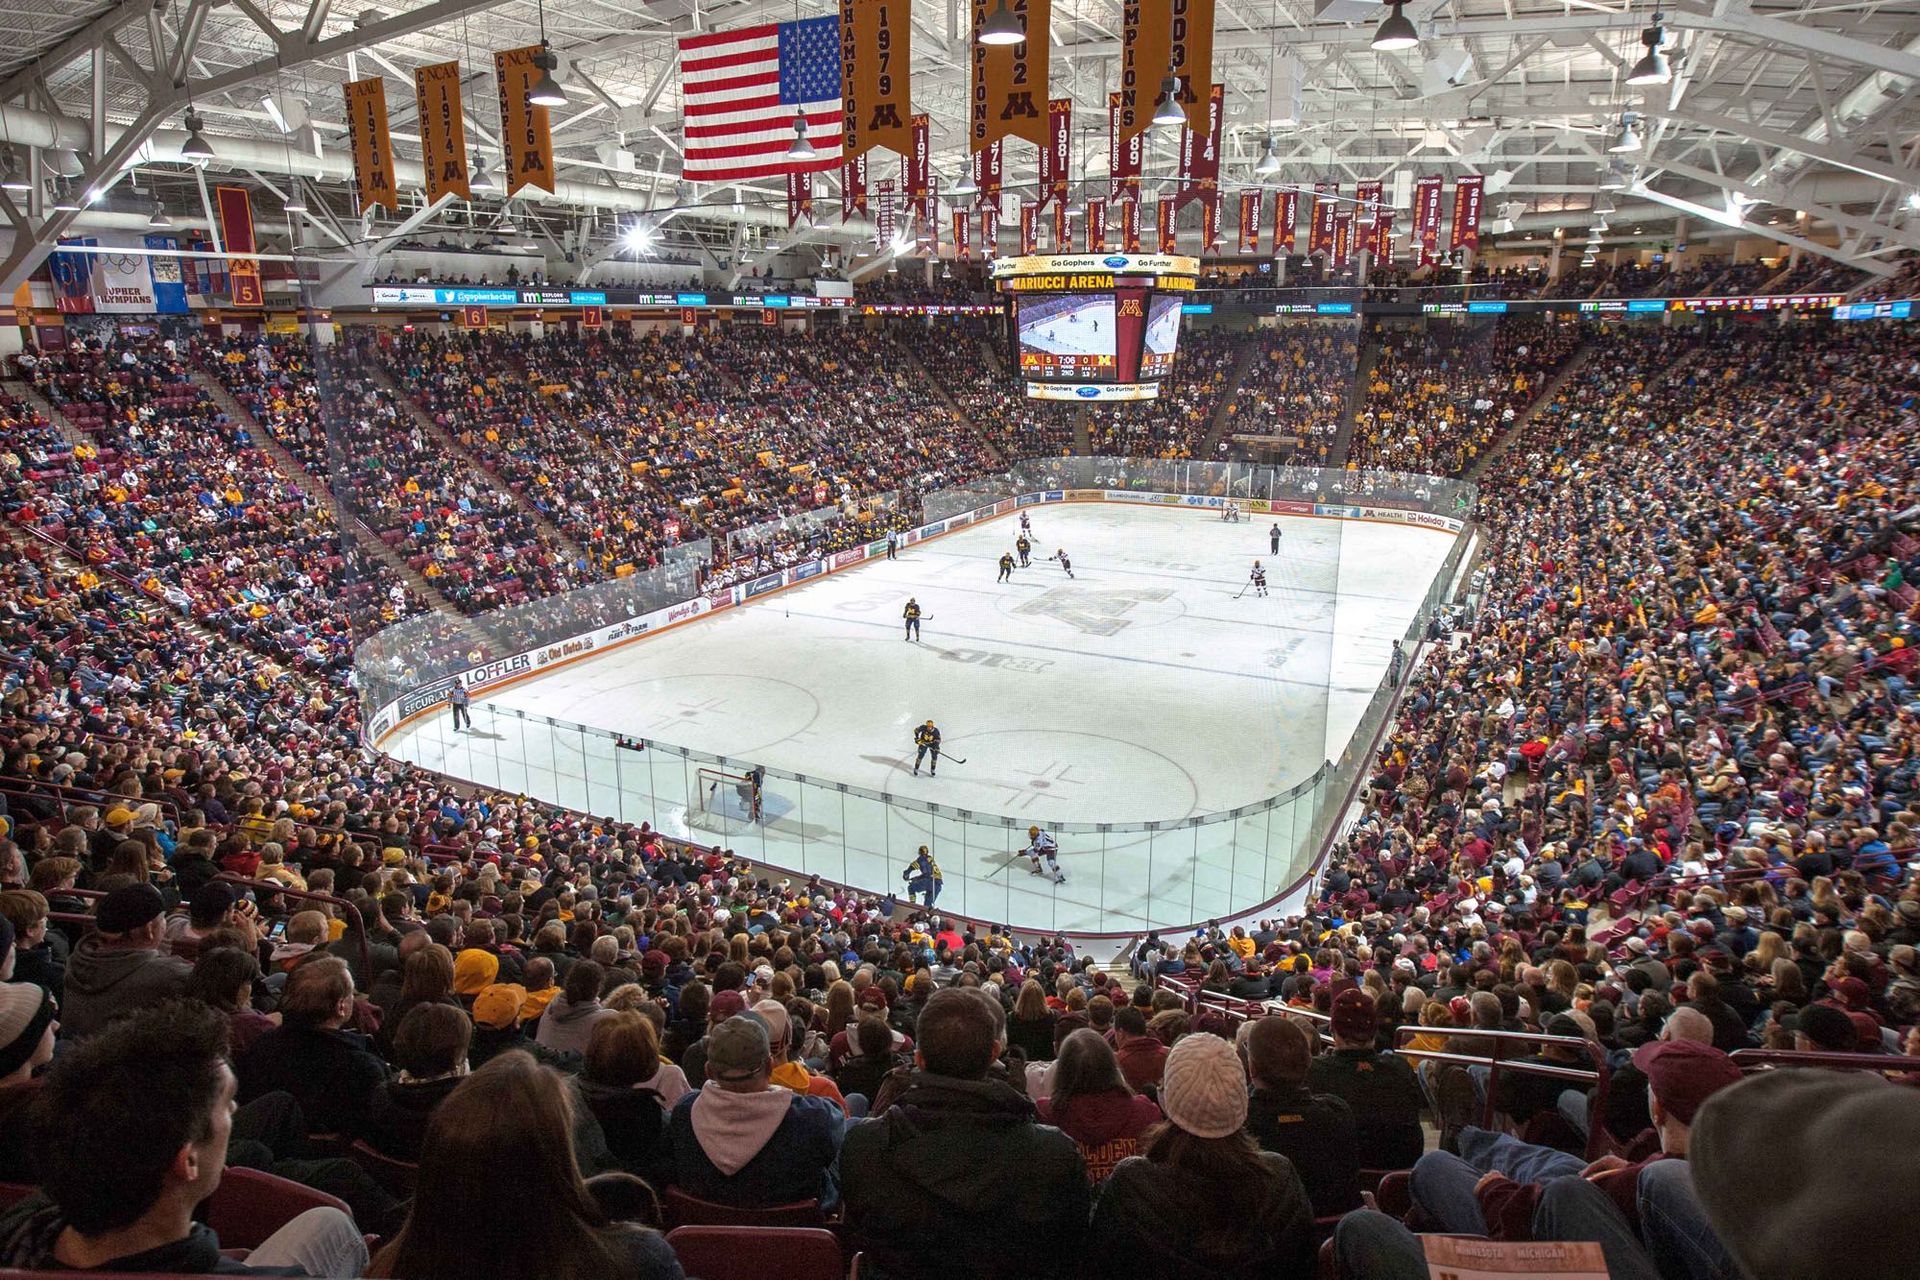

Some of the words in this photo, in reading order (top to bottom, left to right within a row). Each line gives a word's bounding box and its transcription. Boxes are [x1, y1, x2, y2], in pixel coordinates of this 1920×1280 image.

[878, 6, 892, 96] 1979
[427, 65, 459, 82] NCAA
[843, 0, 857, 148] HAMPIONS
[356, 78, 379, 97] AAU
[522, 73, 536, 145] 1976
[440, 86, 454, 154] 1974
[496, 55, 515, 186] CHAMPIONS
[367, 101, 380, 166] 1940
[418, 71, 437, 194] CHAMPIONS
[1058, 116, 1067, 171] 1981
[917, 129, 925, 182] 1971
[1427, 189, 1438, 226] 2012
[1468, 188, 1479, 225] 2013
[1063, 259, 1095, 267] Gophers
[1012, 276, 1065, 290] MARIUCCI
[1069, 275, 1114, 288] ARENA
[242, 286, 253, 301] 5
[457, 291, 516, 304] @gopherhockey
[471, 311, 480, 323] 6
[589, 311, 596, 323] 7
[685, 310, 692, 322] 8
[766, 309, 772, 321] 9
[1083, 356, 1089, 364] 0
[1377, 511, 1402, 519] HEALTH
[1417, 514, 1446, 528] Holiday
[608, 630, 623, 641] FLEET
[631, 622, 648, 633] FARM
[549, 645, 562, 659] Old
[563, 641, 583, 657] Dutch
[466, 655, 530, 685] LOFFLER
[1455, 1244, 1503, 1261] MINNESOTA
[1516, 1247, 1566, 1260] MICHIGAN
